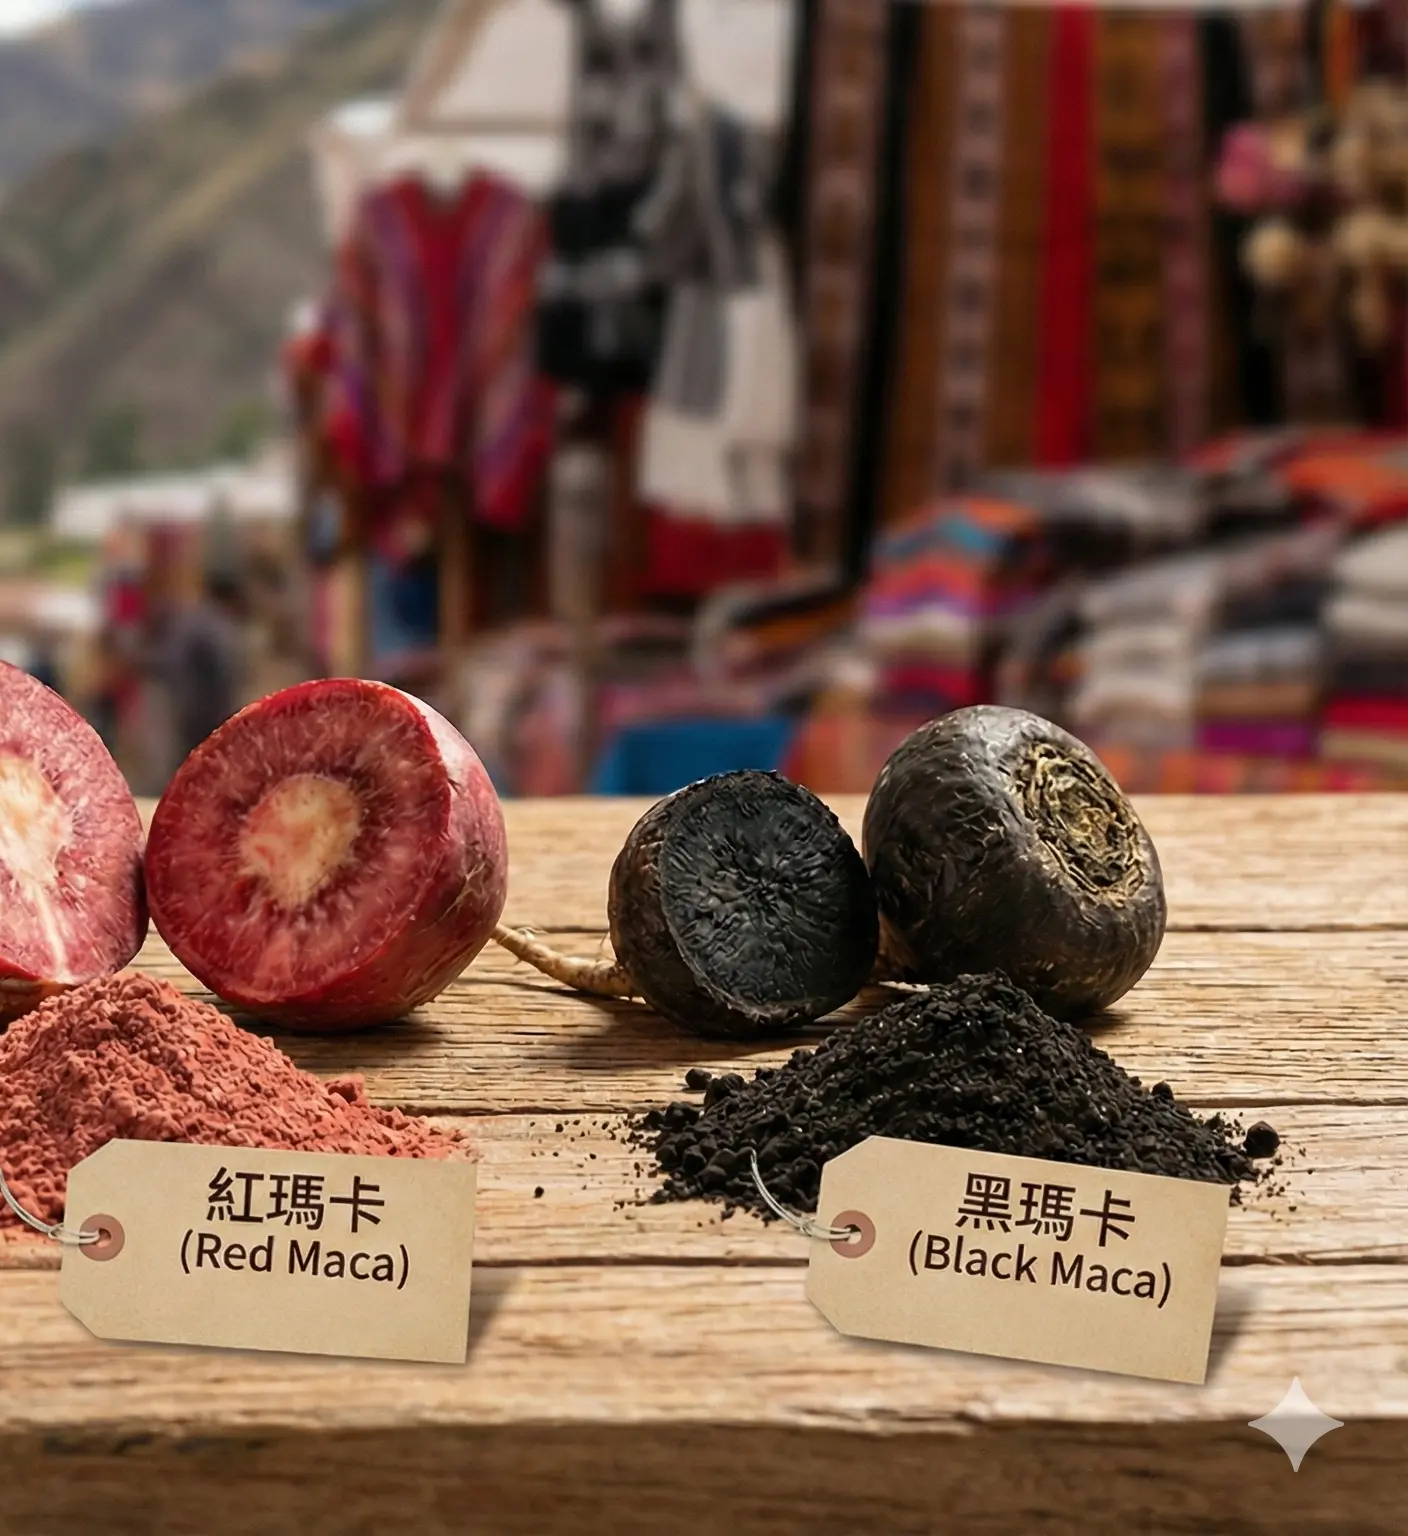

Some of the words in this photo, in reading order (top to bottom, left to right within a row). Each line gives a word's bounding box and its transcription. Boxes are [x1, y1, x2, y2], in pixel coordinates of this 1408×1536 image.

[205, 1166, 386, 1234] 紅瑪卡
[954, 1172, 1136, 1248] 黑瑪卡
[180, 1228, 275, 1275] (Red
[288, 1239, 410, 1290] Maca)
[908, 1229, 1038, 1284] (Black
[1050, 1251, 1172, 1309] Maca)
